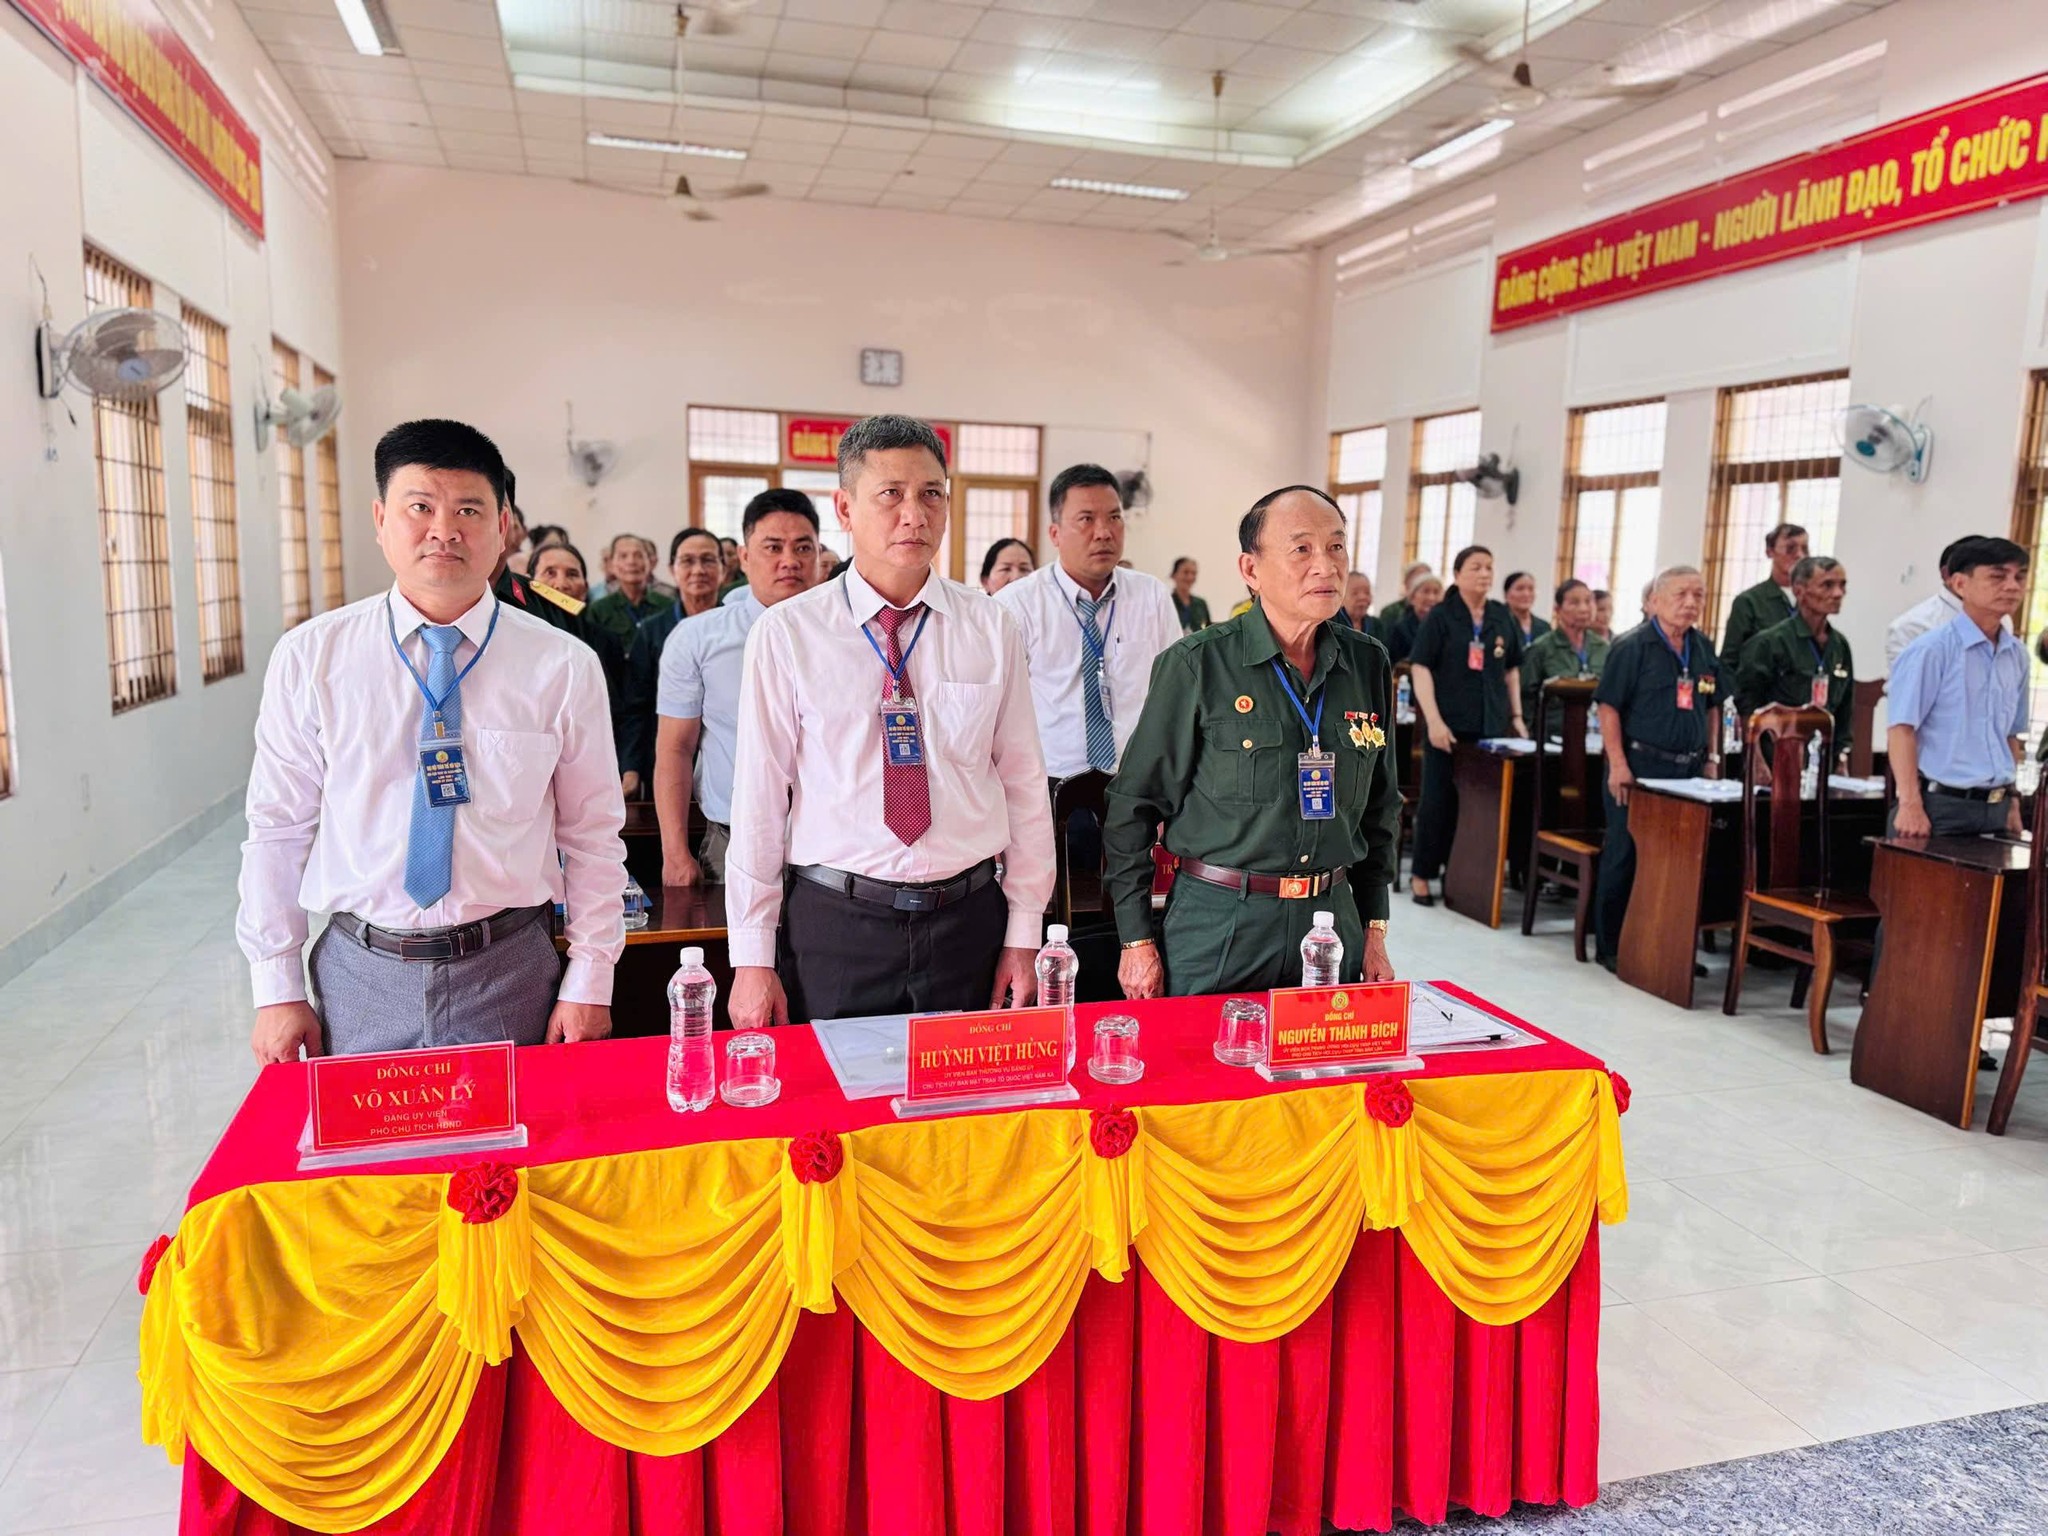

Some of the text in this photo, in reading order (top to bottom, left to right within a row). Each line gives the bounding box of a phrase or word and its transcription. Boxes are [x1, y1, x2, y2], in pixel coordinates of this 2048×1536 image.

[1537, 257, 1580, 304] CỘNG
[1580, 238, 1616, 288] SẢN
[1616, 230, 1654, 282] VIỆT
[1654, 219, 1699, 267] NAM
[1713, 187, 1779, 251] NGƯỜI
[1780, 178, 1843, 232] LÃNH
[1845, 158, 1903, 218] ĐẠO,
[1910, 125, 1950, 197] TỔ
[1950, 115, 2032, 186] CHỨC
[1278, 1021, 1398, 1045] NGUYỄN THÀNH BÍCH
[920, 1037, 1058, 1068] HUỲNH VIỆT HÙNG
[377, 1059, 451, 1080] ĐỒNG CHÍ
[352, 1079, 476, 1110] VÕ XUÂN LÝ
